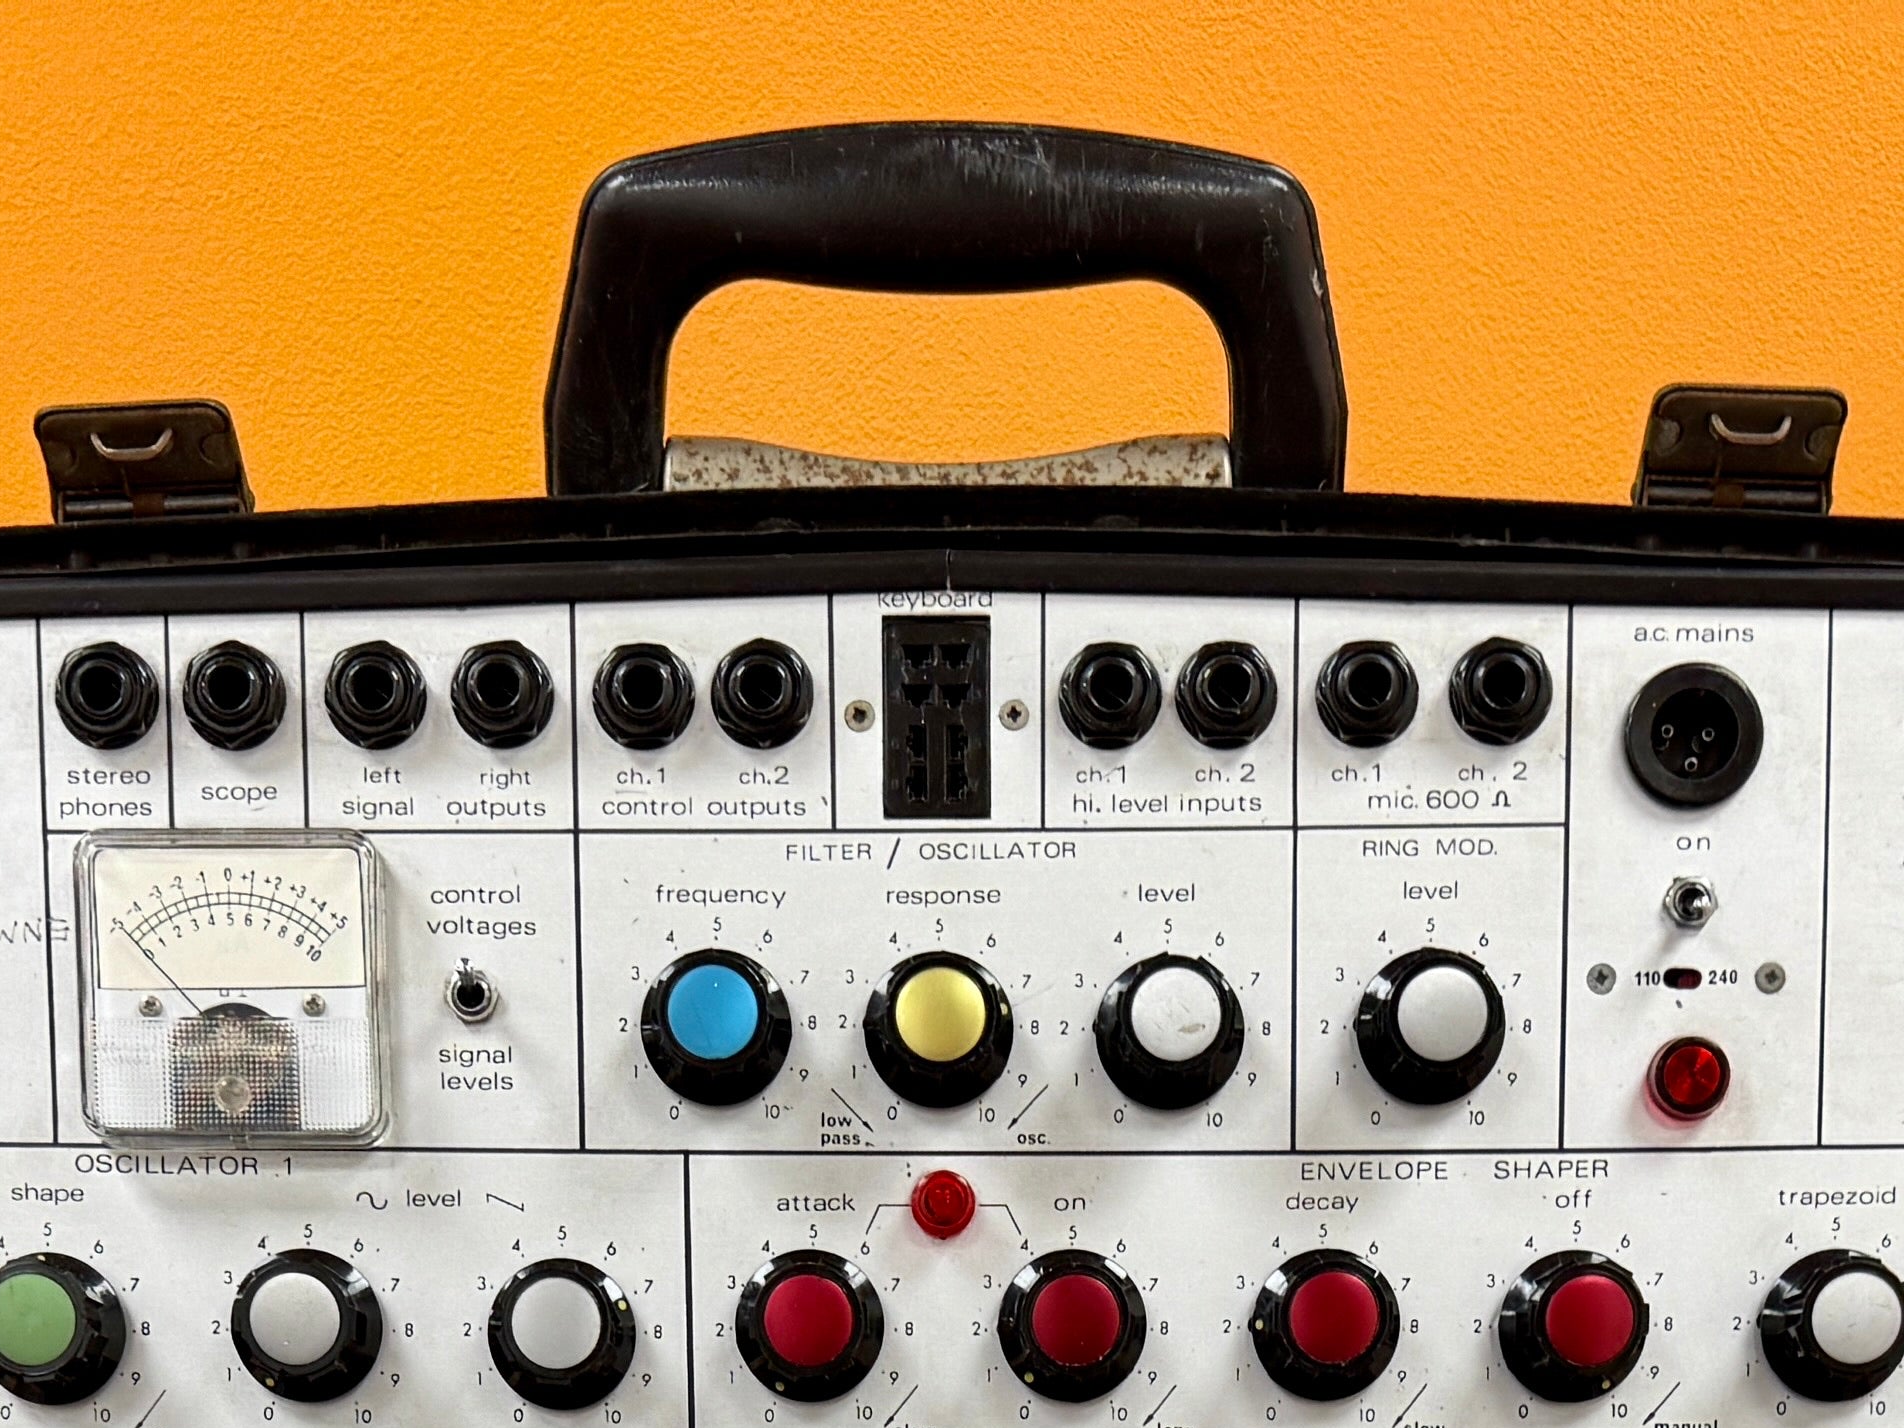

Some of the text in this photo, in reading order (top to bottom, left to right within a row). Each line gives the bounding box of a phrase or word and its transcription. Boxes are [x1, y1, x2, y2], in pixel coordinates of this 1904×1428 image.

[878, 592, 992, 611] keyboard
[1634, 628, 1753, 642] a.c. mains
[68, 769, 150, 784] stereo
[364, 767, 400, 783] left
[481, 768, 530, 789] right
[617, 768, 664, 784] ch.1
[202, 786, 277, 804] scope
[1369, 790, 1479, 809] mic. 600
[60, 798, 152, 818] phones
[343, 798, 545, 823] signal outputs
[603, 798, 805, 819] control outputs
[1074, 794, 1261, 815] hi. level inputs
[787, 842, 1075, 861] FILTER OSCILLATOR
[1363, 839, 1497, 856] RING MOD.
[1677, 837, 1710, 850] on
[431, 885, 520, 904] control
[657, 885, 785, 908] frequency
[887, 890, 1000, 907] response
[1139, 884, 1194, 902] level
[1404, 881, 1457, 899] level
[427, 916, 536, 939] voltages
[1636, 971, 1660, 985] 110
[1709, 970, 1737, 984] 240
[439, 1046, 511, 1067] signal
[442, 1072, 513, 1090] levels
[822, 1112, 851, 1127] low
[822, 1134, 860, 1146] pass
[1017, 1131, 1051, 1146] osc.
[76, 1152, 257, 1175] OSCILLATOR
[1302, 1162, 1447, 1180] ENVELOPE
[1494, 1160, 1608, 1179] SHAPER
[12, 1183, 84, 1205] shape
[407, 1190, 460, 1207] level
[777, 1193, 855, 1211] attack
[1286, 1193, 1358, 1213] decay
[1556, 1190, 1591, 1208] off
[1780, 1187, 1895, 1208] trapezoid
[1054, 1198, 1085, 1211] on
